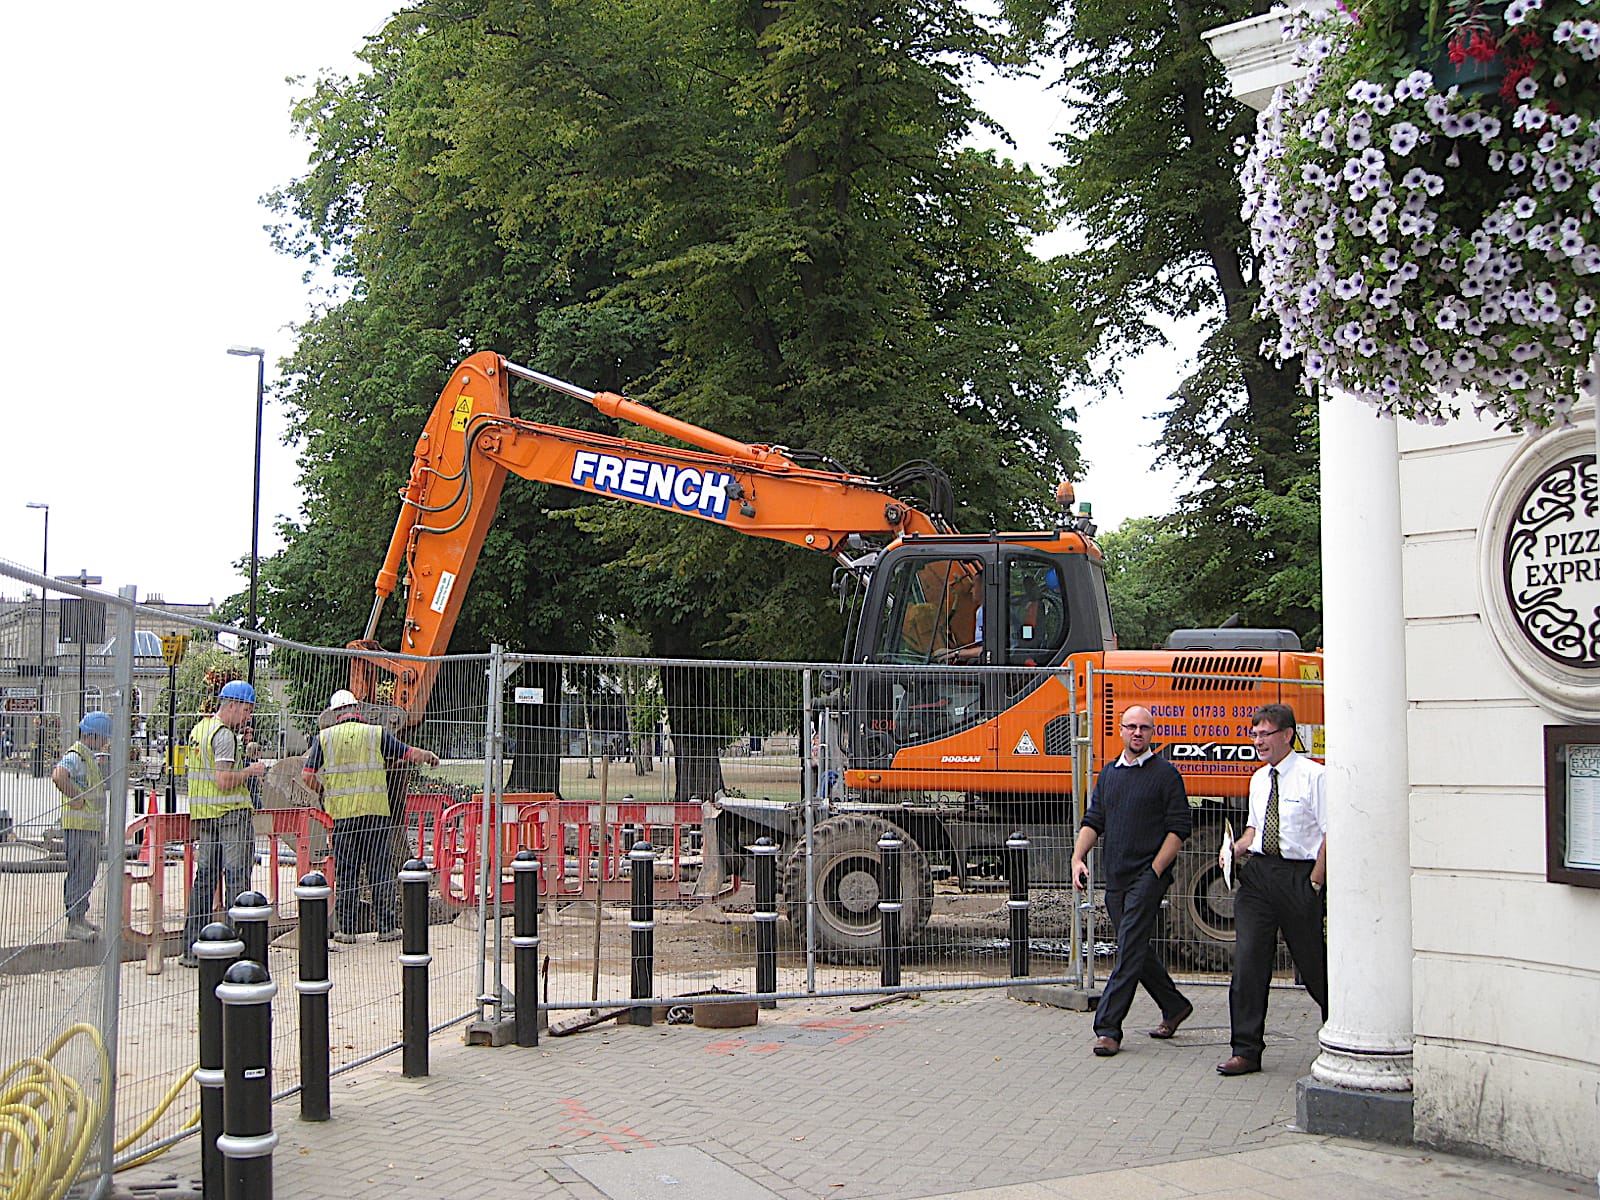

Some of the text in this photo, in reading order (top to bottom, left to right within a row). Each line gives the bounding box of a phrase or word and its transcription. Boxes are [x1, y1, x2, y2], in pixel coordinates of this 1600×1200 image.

[571, 450, 735, 519] FRENCH
[1151, 705, 1185, 718] RUGBY
[1193, 724, 1230, 737] 07860
[940, 755, 982, 763] DOOSAN
